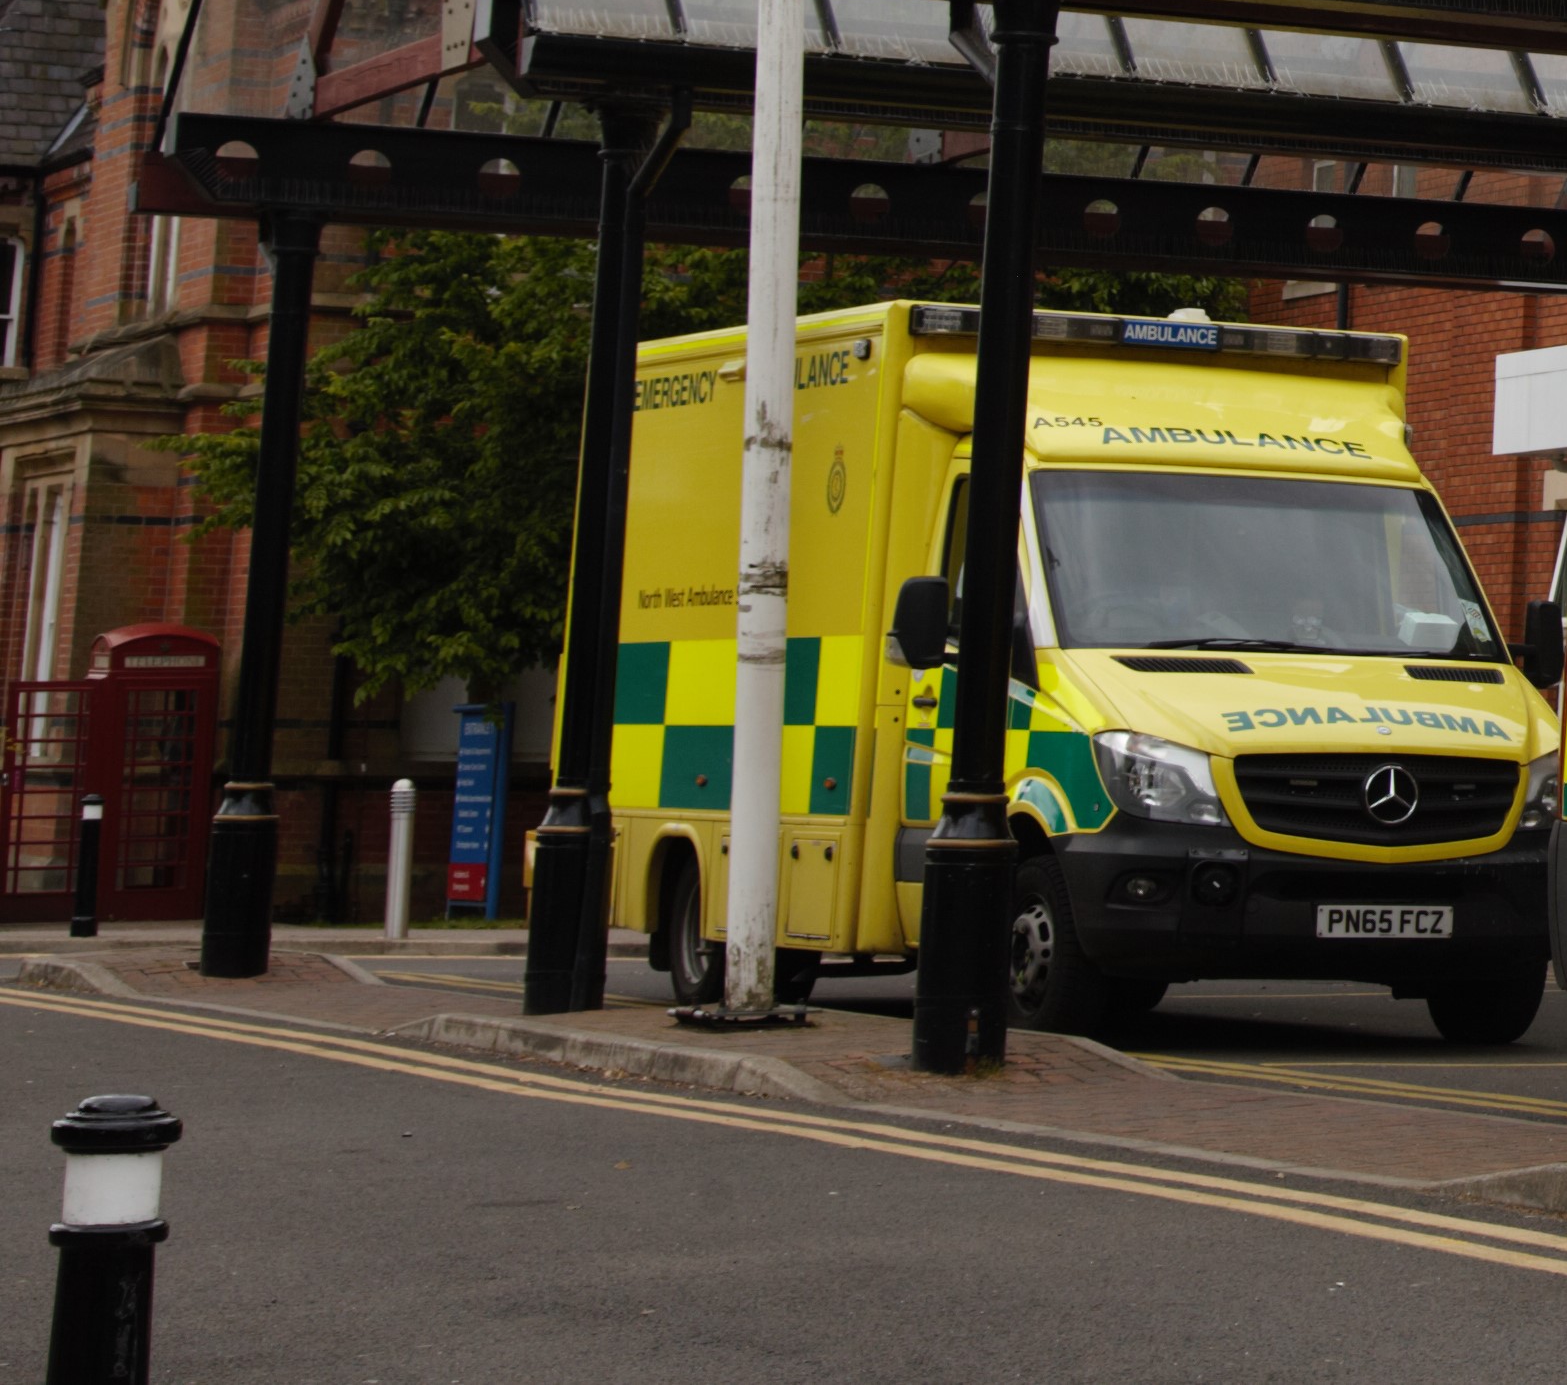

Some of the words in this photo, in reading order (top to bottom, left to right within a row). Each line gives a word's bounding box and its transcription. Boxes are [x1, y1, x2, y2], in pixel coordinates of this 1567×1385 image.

[1124, 324, 1218, 346] AMBULANCE
[1033, 417, 1104, 429] A545
[1102, 427, 1373, 460] AMBULANCE
[638, 587, 662, 609] North
[665, 588, 685, 608] West
[687, 584, 734, 607] Ambulance
[1328, 910, 1393, 933] PN65
[1400, 910, 1444, 934] FCZ
